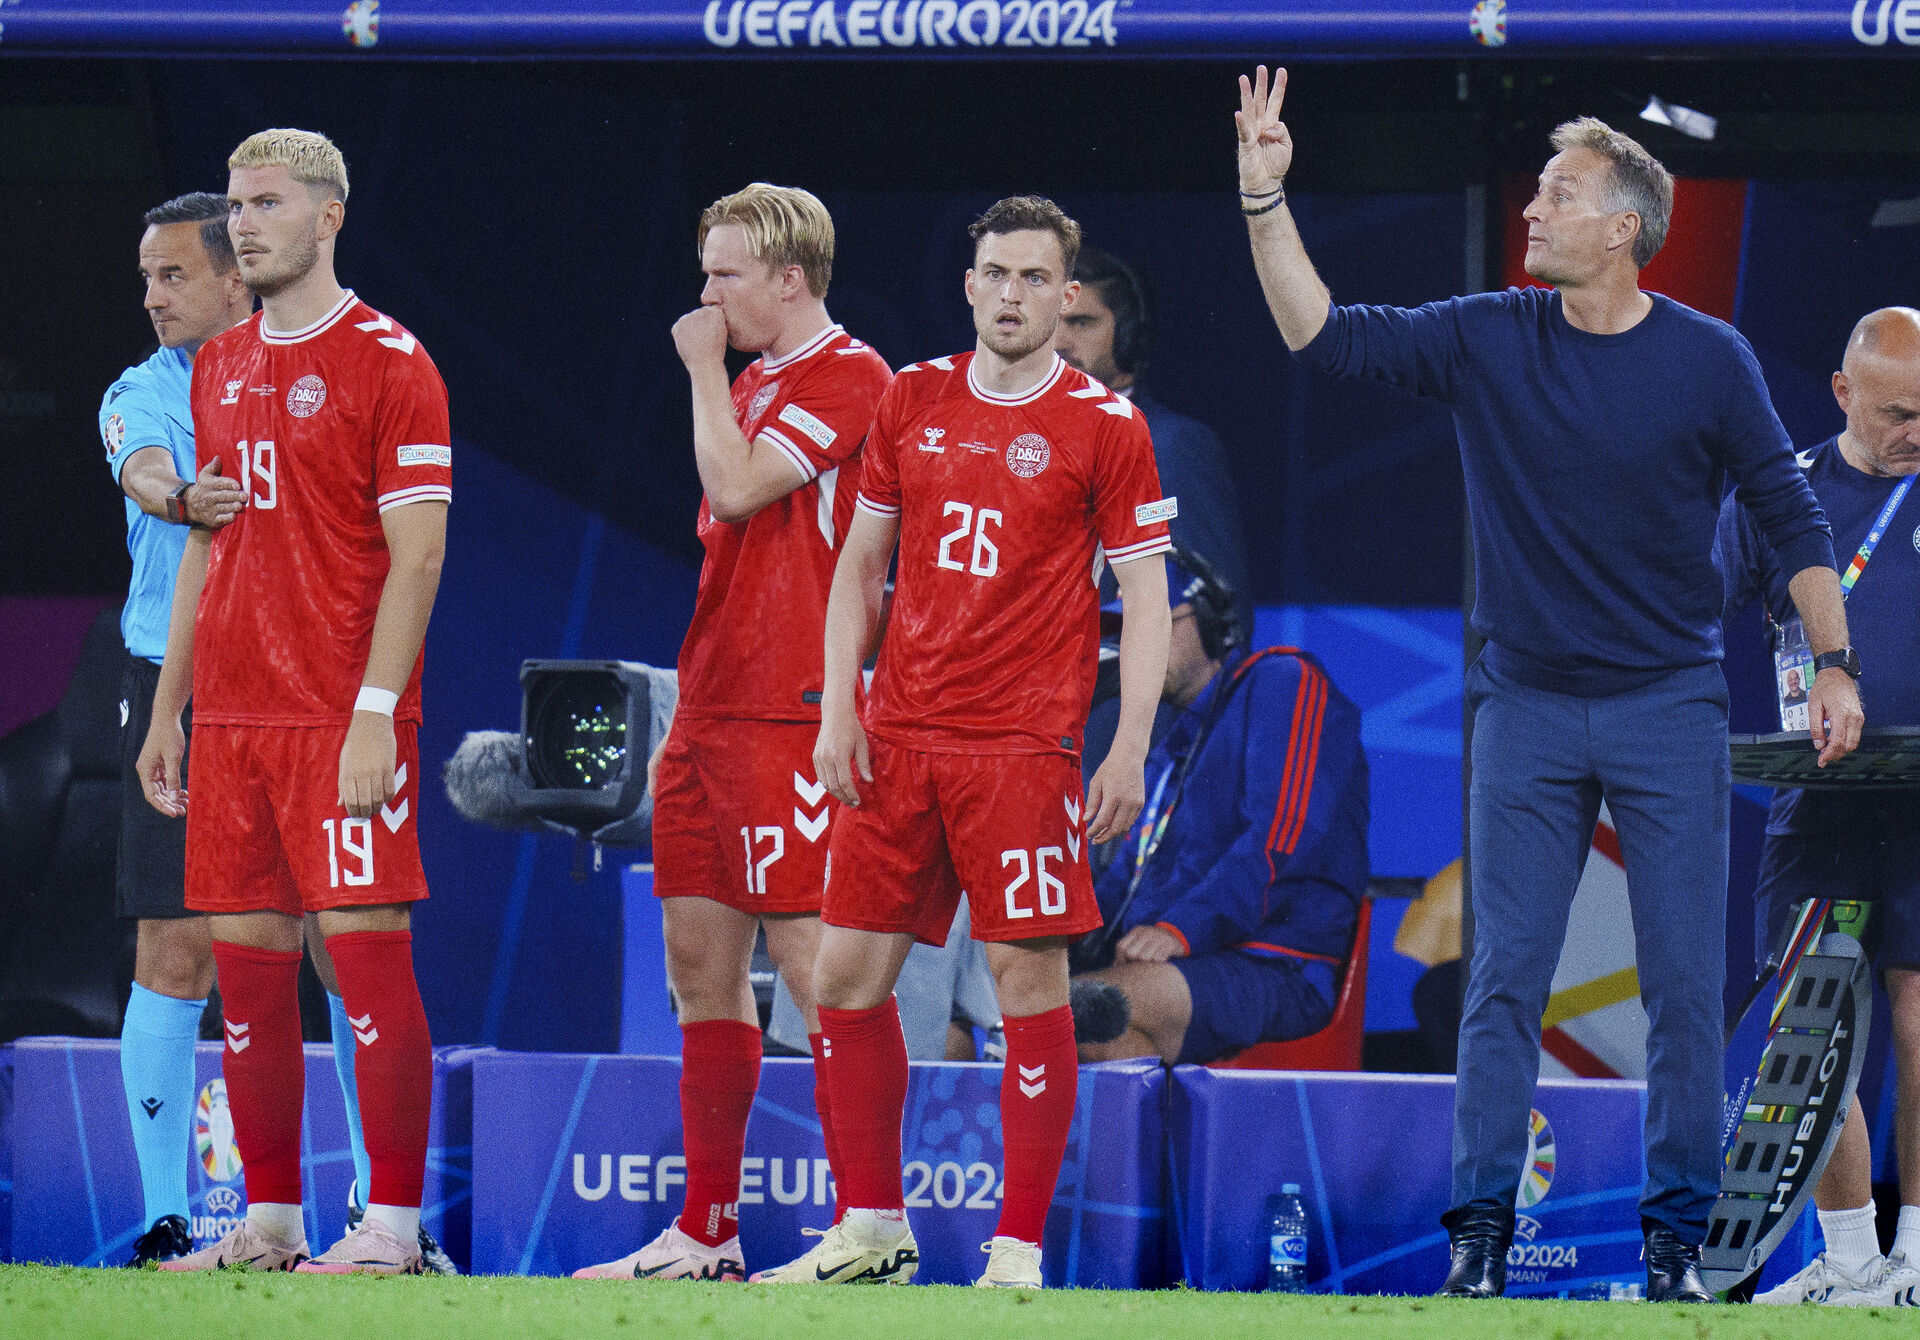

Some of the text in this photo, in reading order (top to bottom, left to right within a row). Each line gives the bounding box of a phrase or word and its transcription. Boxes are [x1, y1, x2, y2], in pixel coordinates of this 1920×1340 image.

[295, 389, 318, 402] DBU
[784, 408, 832, 443] FOUNDATION
[236, 440, 277, 510] 19
[400, 450, 450, 459] FOUNDATION
[1016, 448, 1042, 462] DBU
[937, 501, 1003, 577] 26
[322, 817, 374, 888] 19
[740, 826, 784, 894] 17
[1001, 846, 1067, 919] 26
[1769, 1020, 1848, 1213] HUBLOT
